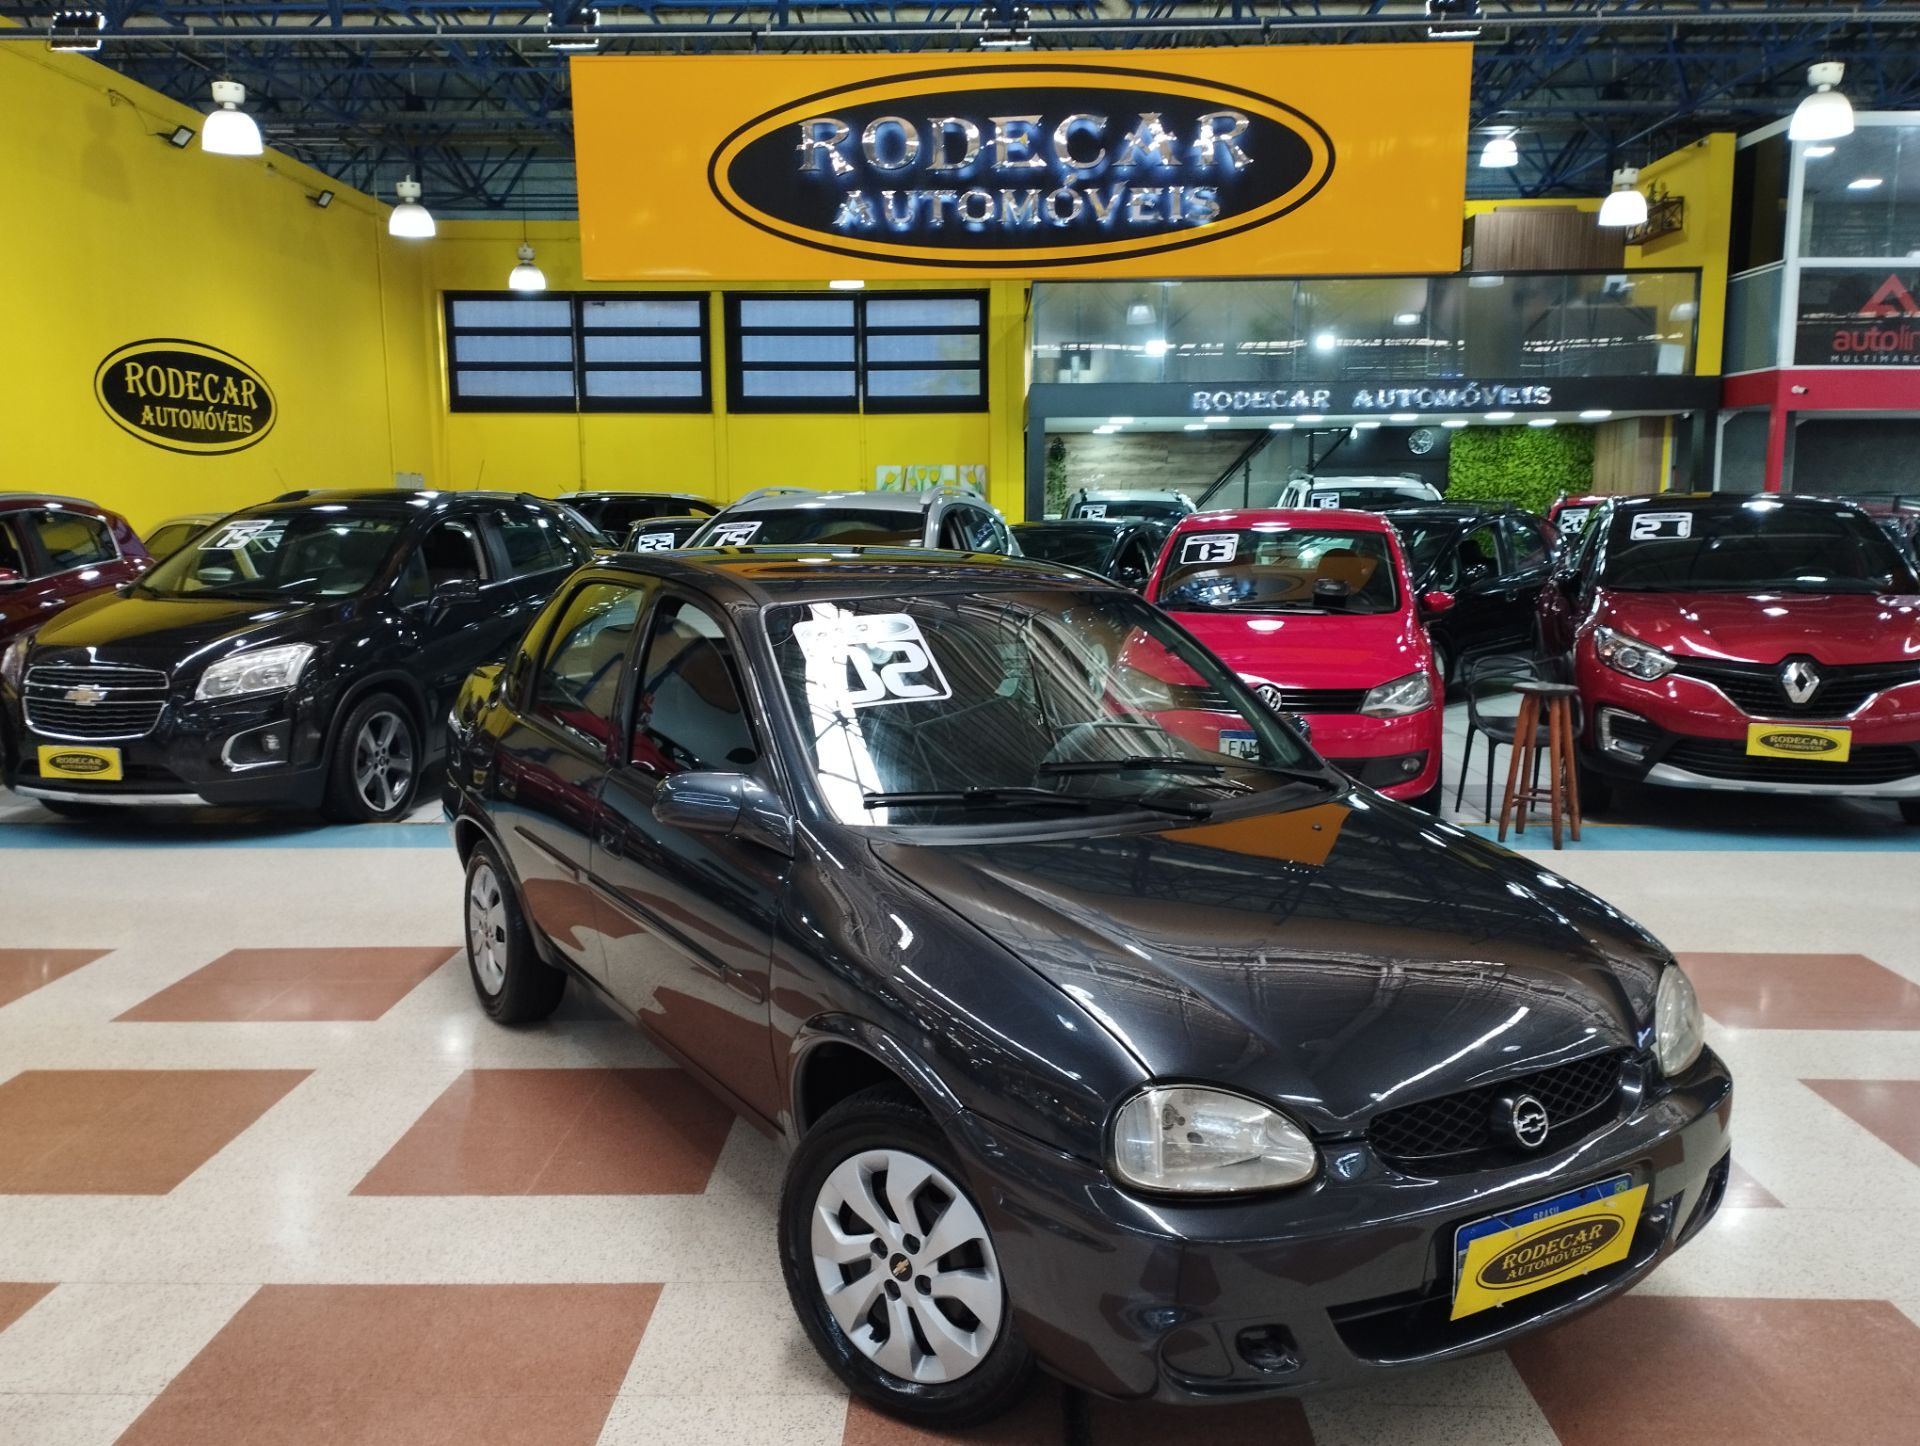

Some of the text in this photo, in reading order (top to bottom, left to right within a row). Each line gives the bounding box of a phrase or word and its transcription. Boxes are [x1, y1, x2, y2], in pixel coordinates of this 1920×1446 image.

[796, 111, 1254, 176] RODECAR
[832, 174, 1221, 227] AUTOMÓVEIS
[125, 361, 258, 410] RODECAR
[1193, 382, 1551, 411] RODECAR AUTOMÓVEIS
[141, 405, 253, 434] AUTOMÓVEIS
[1634, 520, 1688, 538] 21
[1199, 542, 1234, 561] 13
[1769, 735, 1828, 747] RODECAR
[1502, 1224, 1603, 1270] RODECAR
